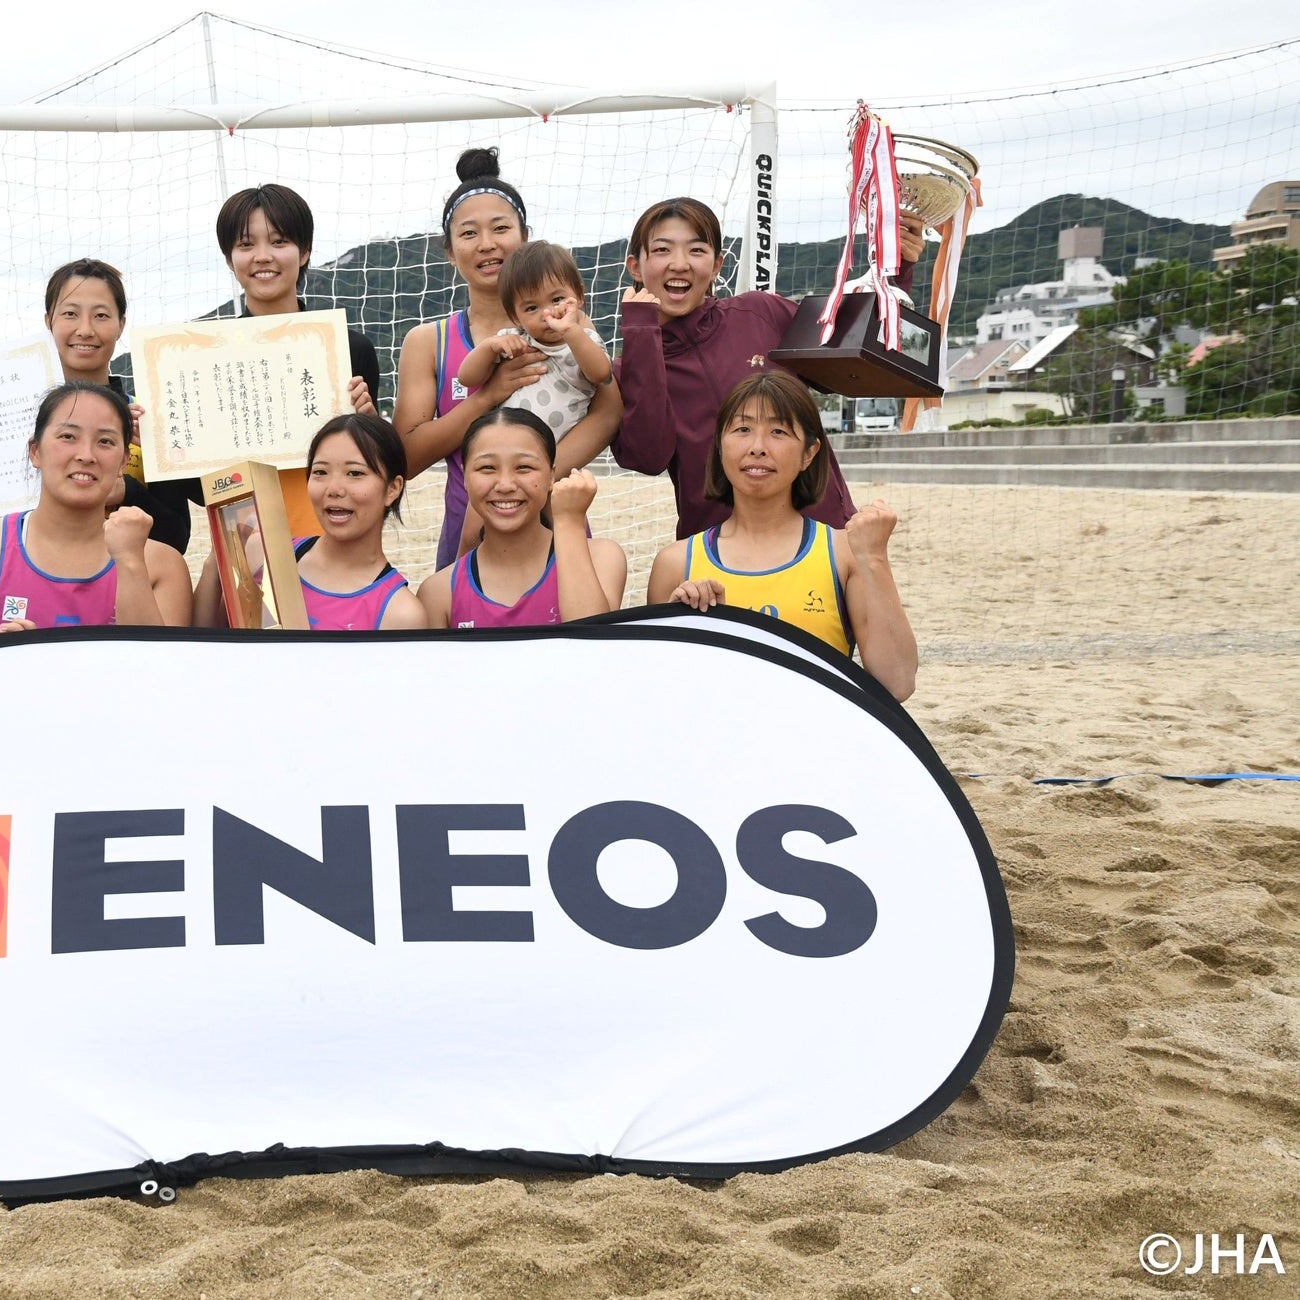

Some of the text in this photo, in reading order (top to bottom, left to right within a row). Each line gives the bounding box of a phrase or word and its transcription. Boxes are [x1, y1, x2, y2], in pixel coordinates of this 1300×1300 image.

[300, 368, 320, 419] 表彰状
[52, 801, 877, 958] ENEOS
